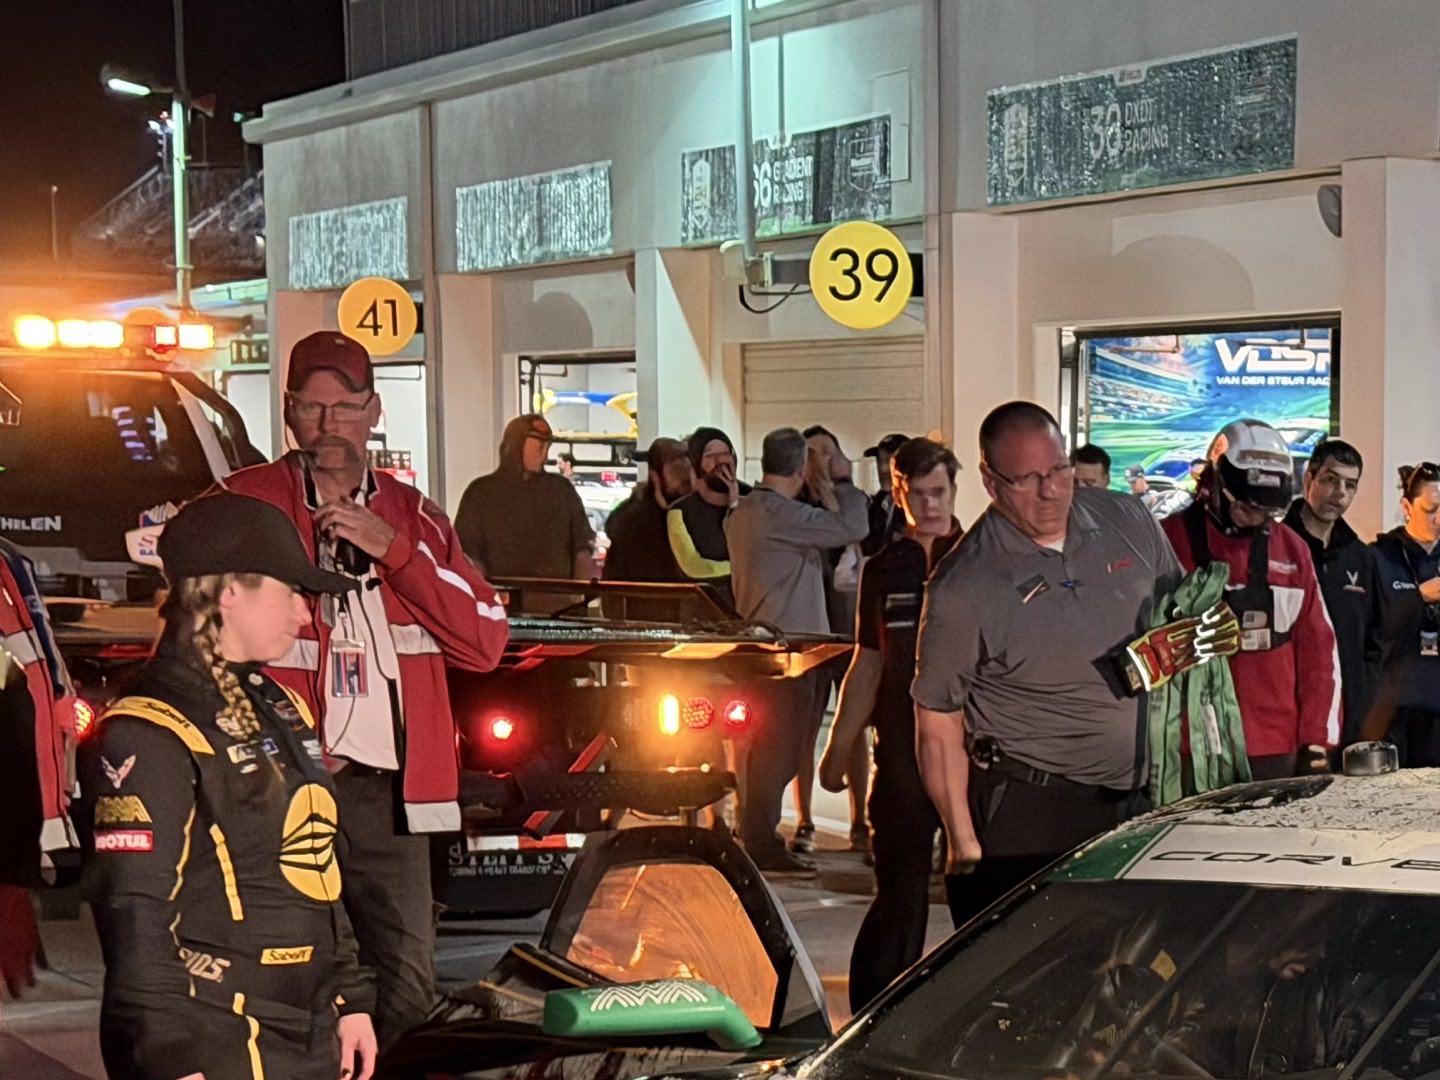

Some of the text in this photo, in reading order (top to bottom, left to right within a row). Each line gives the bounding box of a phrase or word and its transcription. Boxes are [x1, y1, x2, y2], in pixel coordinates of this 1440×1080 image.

[828, 248, 899, 303] 39
[356, 298, 398, 336] 41
[1216, 375, 1329, 386] VAN DER STEUR RAC
[0, 515, 62, 531] HELEN
[95, 833, 150, 850] MOTUL
